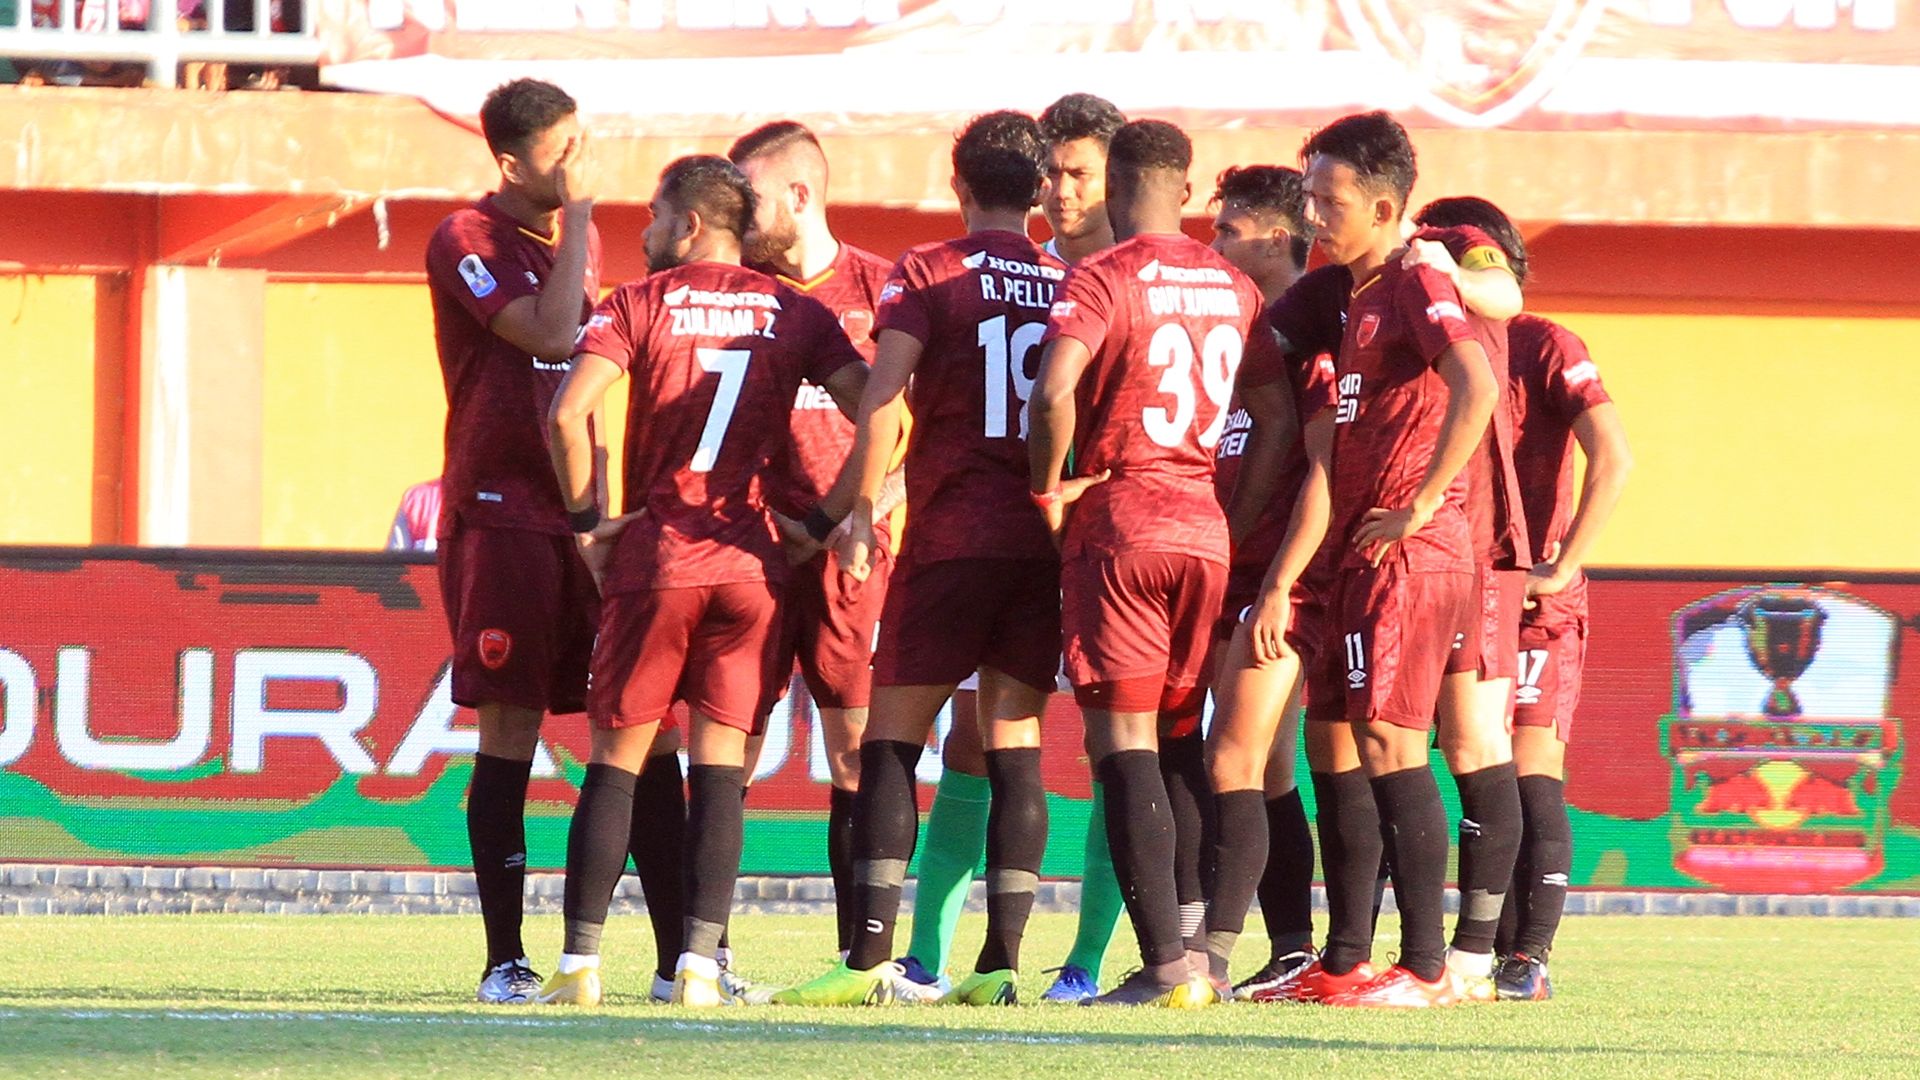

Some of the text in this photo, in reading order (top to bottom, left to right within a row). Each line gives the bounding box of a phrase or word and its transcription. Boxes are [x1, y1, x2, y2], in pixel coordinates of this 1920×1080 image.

[689, 347, 752, 473] 7
[1142, 322, 1243, 448] 39
[1345, 632, 1364, 670] 11
[1517, 649, 1549, 686] 17
